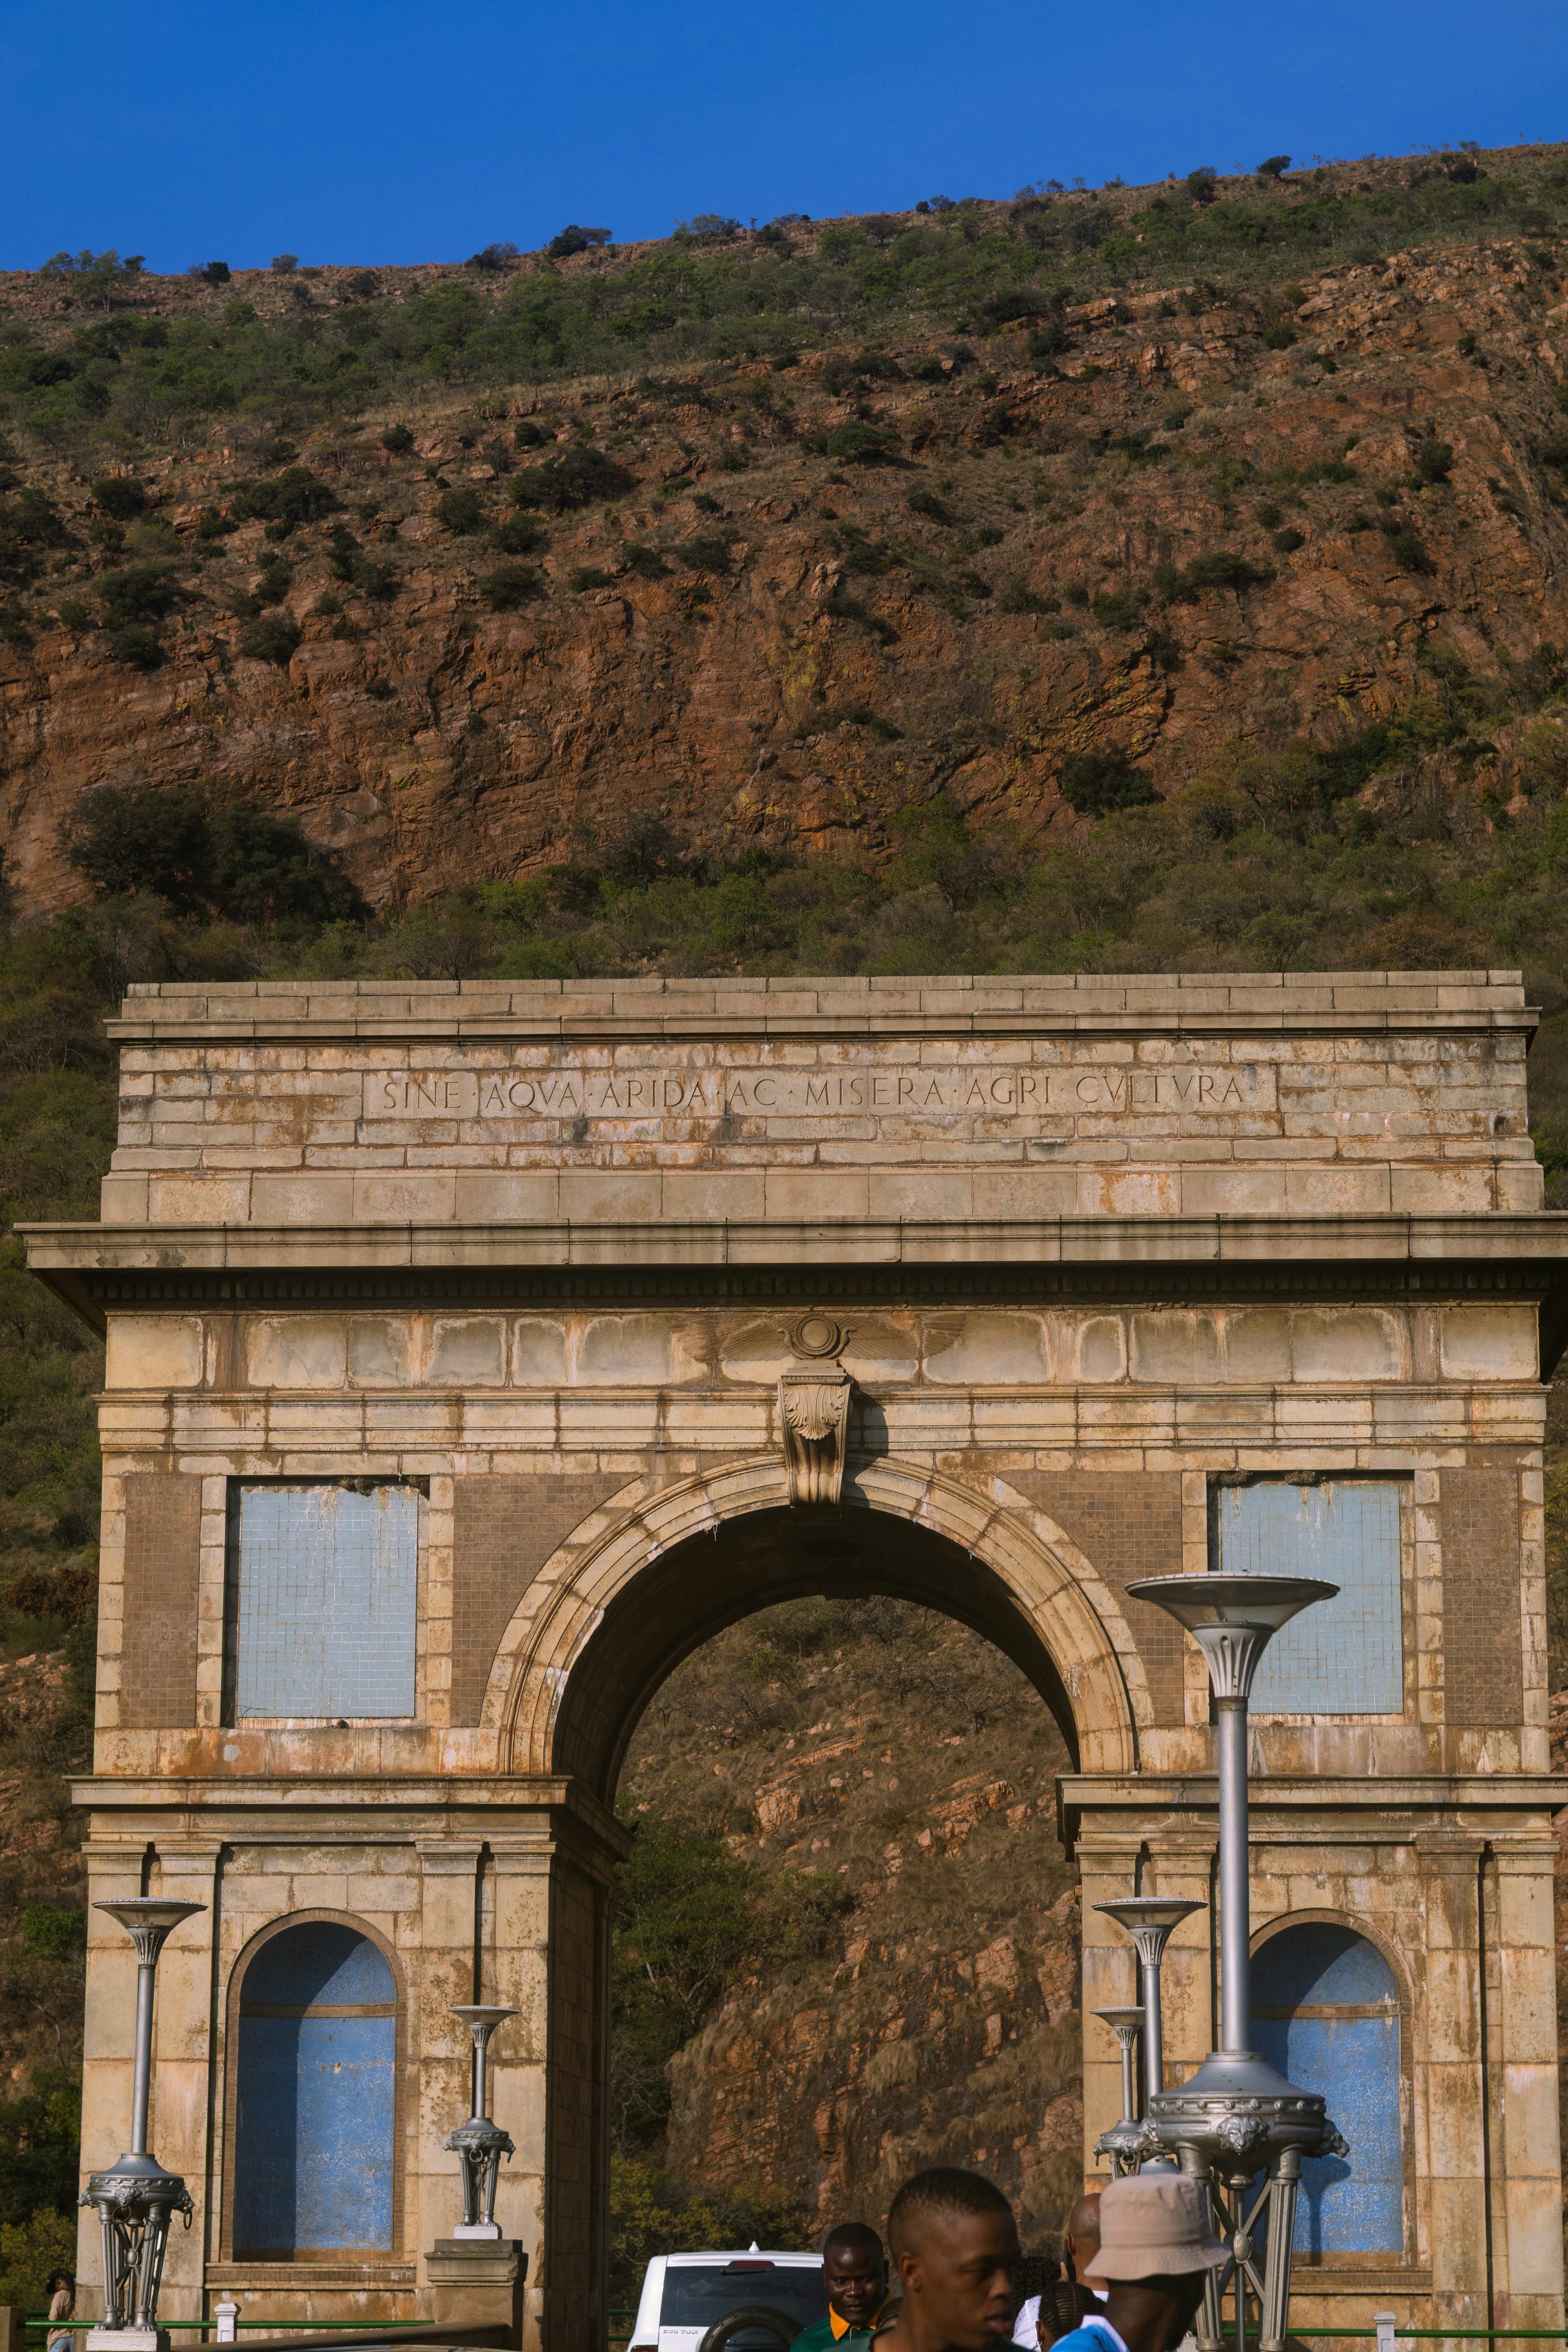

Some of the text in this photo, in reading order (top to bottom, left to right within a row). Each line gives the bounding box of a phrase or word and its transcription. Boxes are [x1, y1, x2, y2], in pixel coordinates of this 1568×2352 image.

[384, 1075, 1246, 1113] SINE AQVA ARIDA AC MISERA AGRI CVLTVRA
